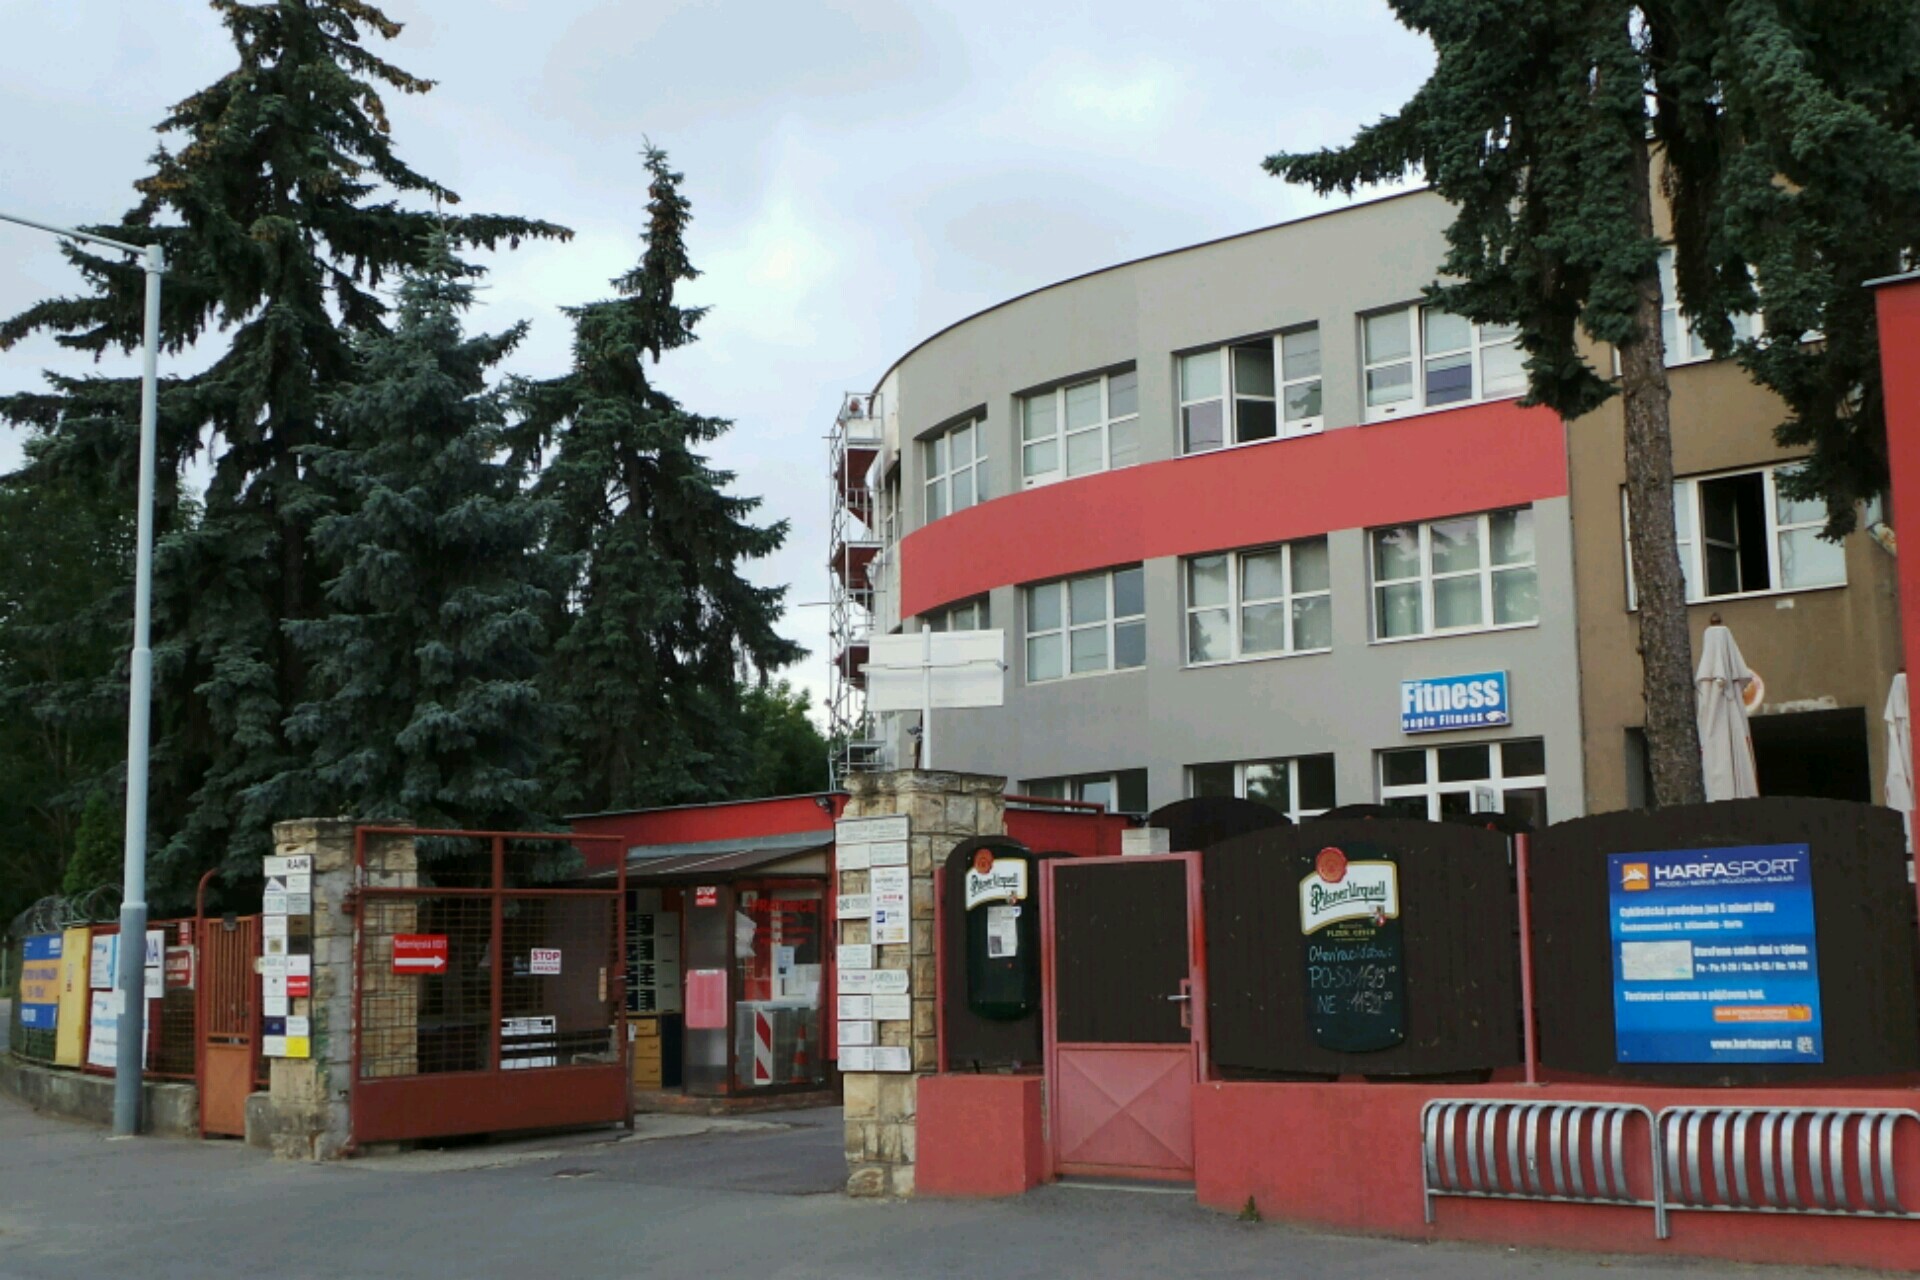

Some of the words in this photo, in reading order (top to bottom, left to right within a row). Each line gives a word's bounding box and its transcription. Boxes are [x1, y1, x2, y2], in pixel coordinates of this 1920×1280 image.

[1402, 680, 1500, 714] Fitness
[1440, 712, 1483, 726] Fitness
[1655, 858, 1799, 880] HARFASPORT
[1310, 883, 1348, 915] Pilsner
[1347, 880, 1386, 904] Urquell
[533, 951, 560, 961] STOP
[1711, 1038, 1793, 1051] www.harfasport.cz
